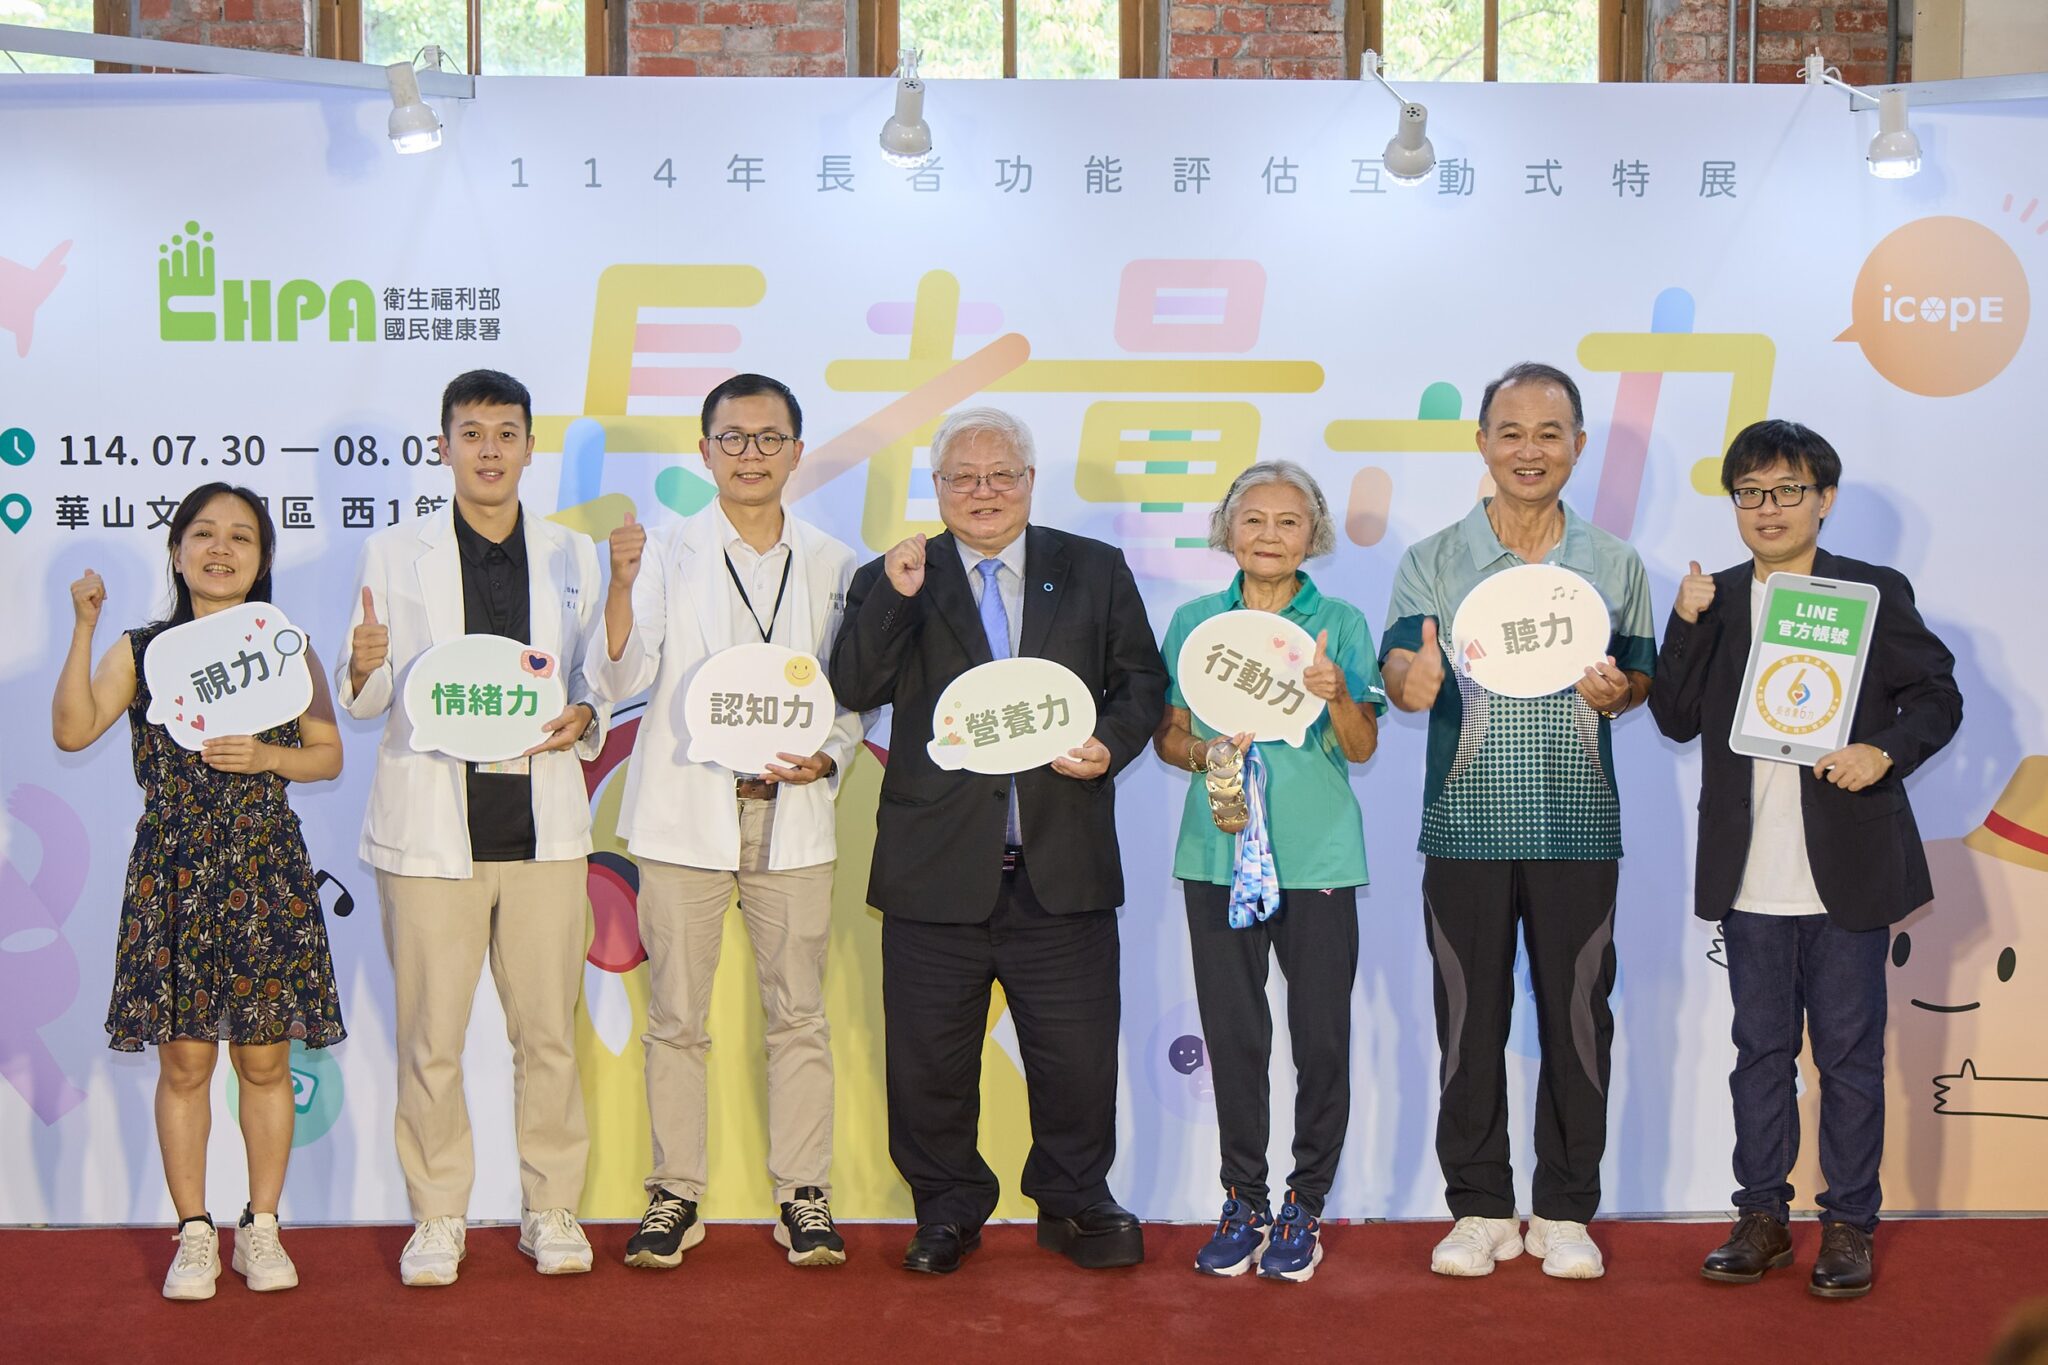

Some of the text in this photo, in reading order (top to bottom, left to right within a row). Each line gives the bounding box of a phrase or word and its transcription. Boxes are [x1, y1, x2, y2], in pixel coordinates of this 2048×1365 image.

[383, 286, 501, 312] 衛生福利部
[384, 317, 501, 341] 國民健康署
[1795, 602, 1839, 622] LINE
[1501, 612, 1573, 655] 聽力
[1778, 619, 1850, 646] 官方帳號
[190, 649, 271, 704] 視力
[1204, 643, 1306, 716] 行動力
[430, 681, 540, 718] 情緒力
[709, 692, 814, 729] 認知力
[964, 693, 1071, 749] 營養力
